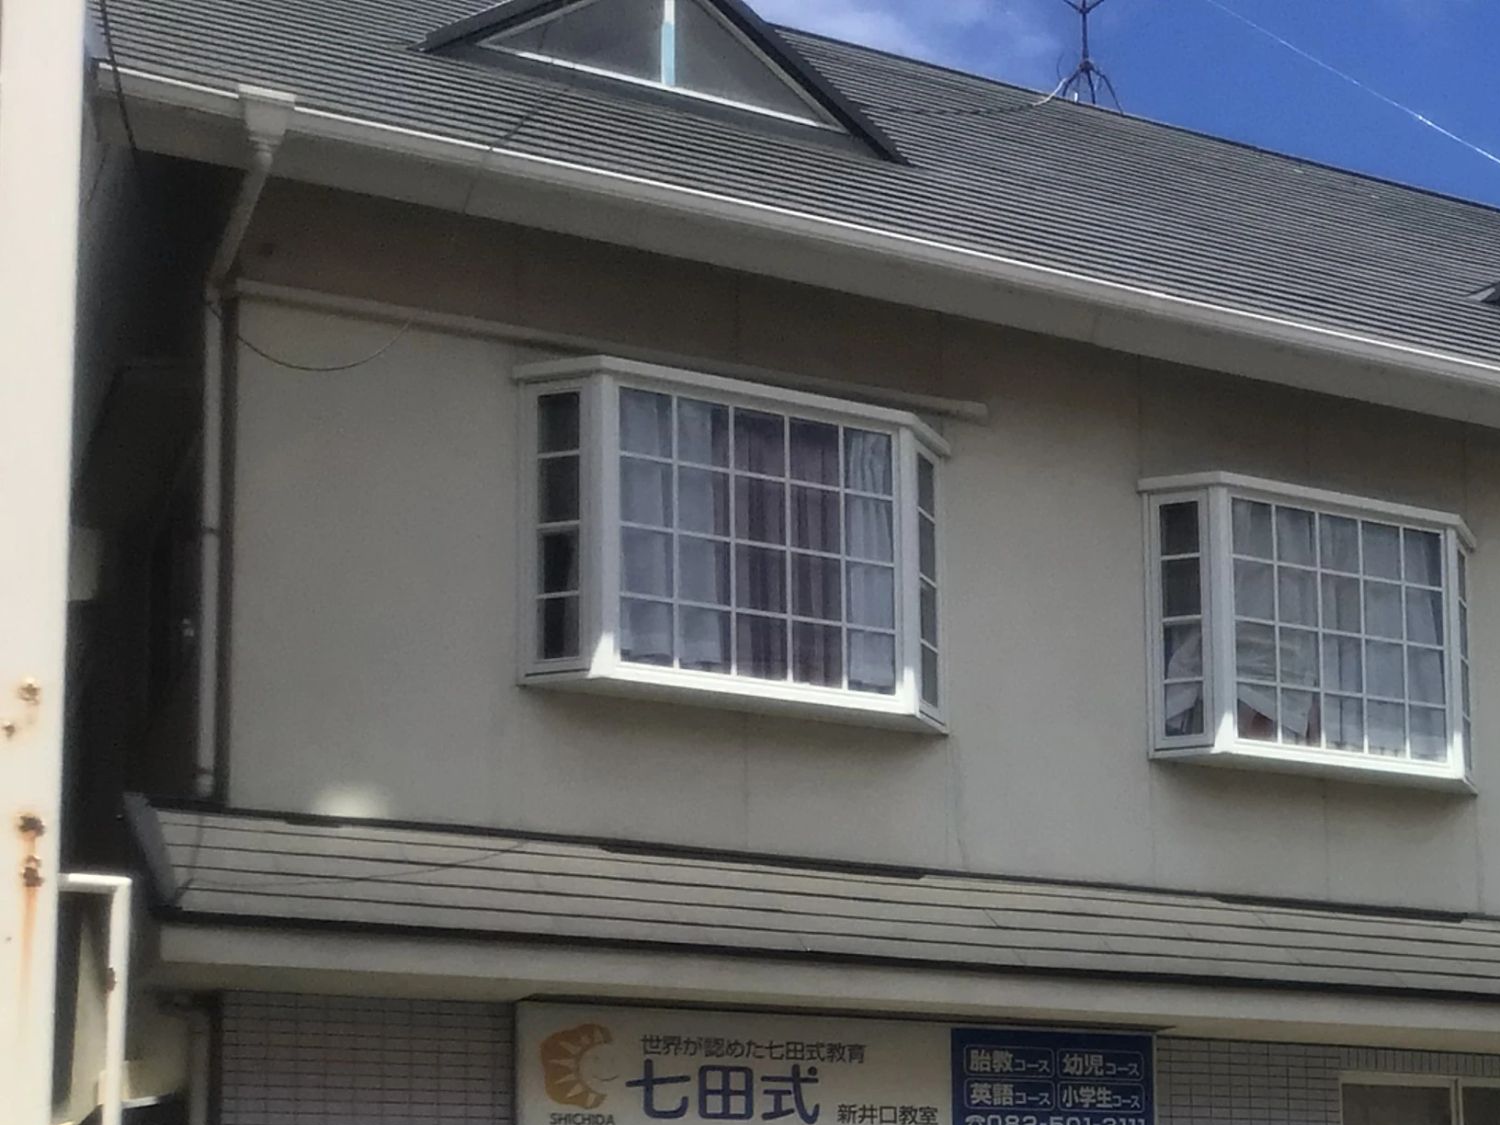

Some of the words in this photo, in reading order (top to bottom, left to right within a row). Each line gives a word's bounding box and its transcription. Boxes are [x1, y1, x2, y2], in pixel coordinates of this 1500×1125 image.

[641, 1034, 866, 1064] 世界が認めた七田式教育
[1062, 1053, 1140, 1077] 幼児コース
[625, 1058, 820, 1125] 七田式
[970, 1082, 1050, 1106] 英語コース
[1062, 1086, 1141, 1109] 小学生コース
[837, 1104, 939, 1125] 新井口教室
